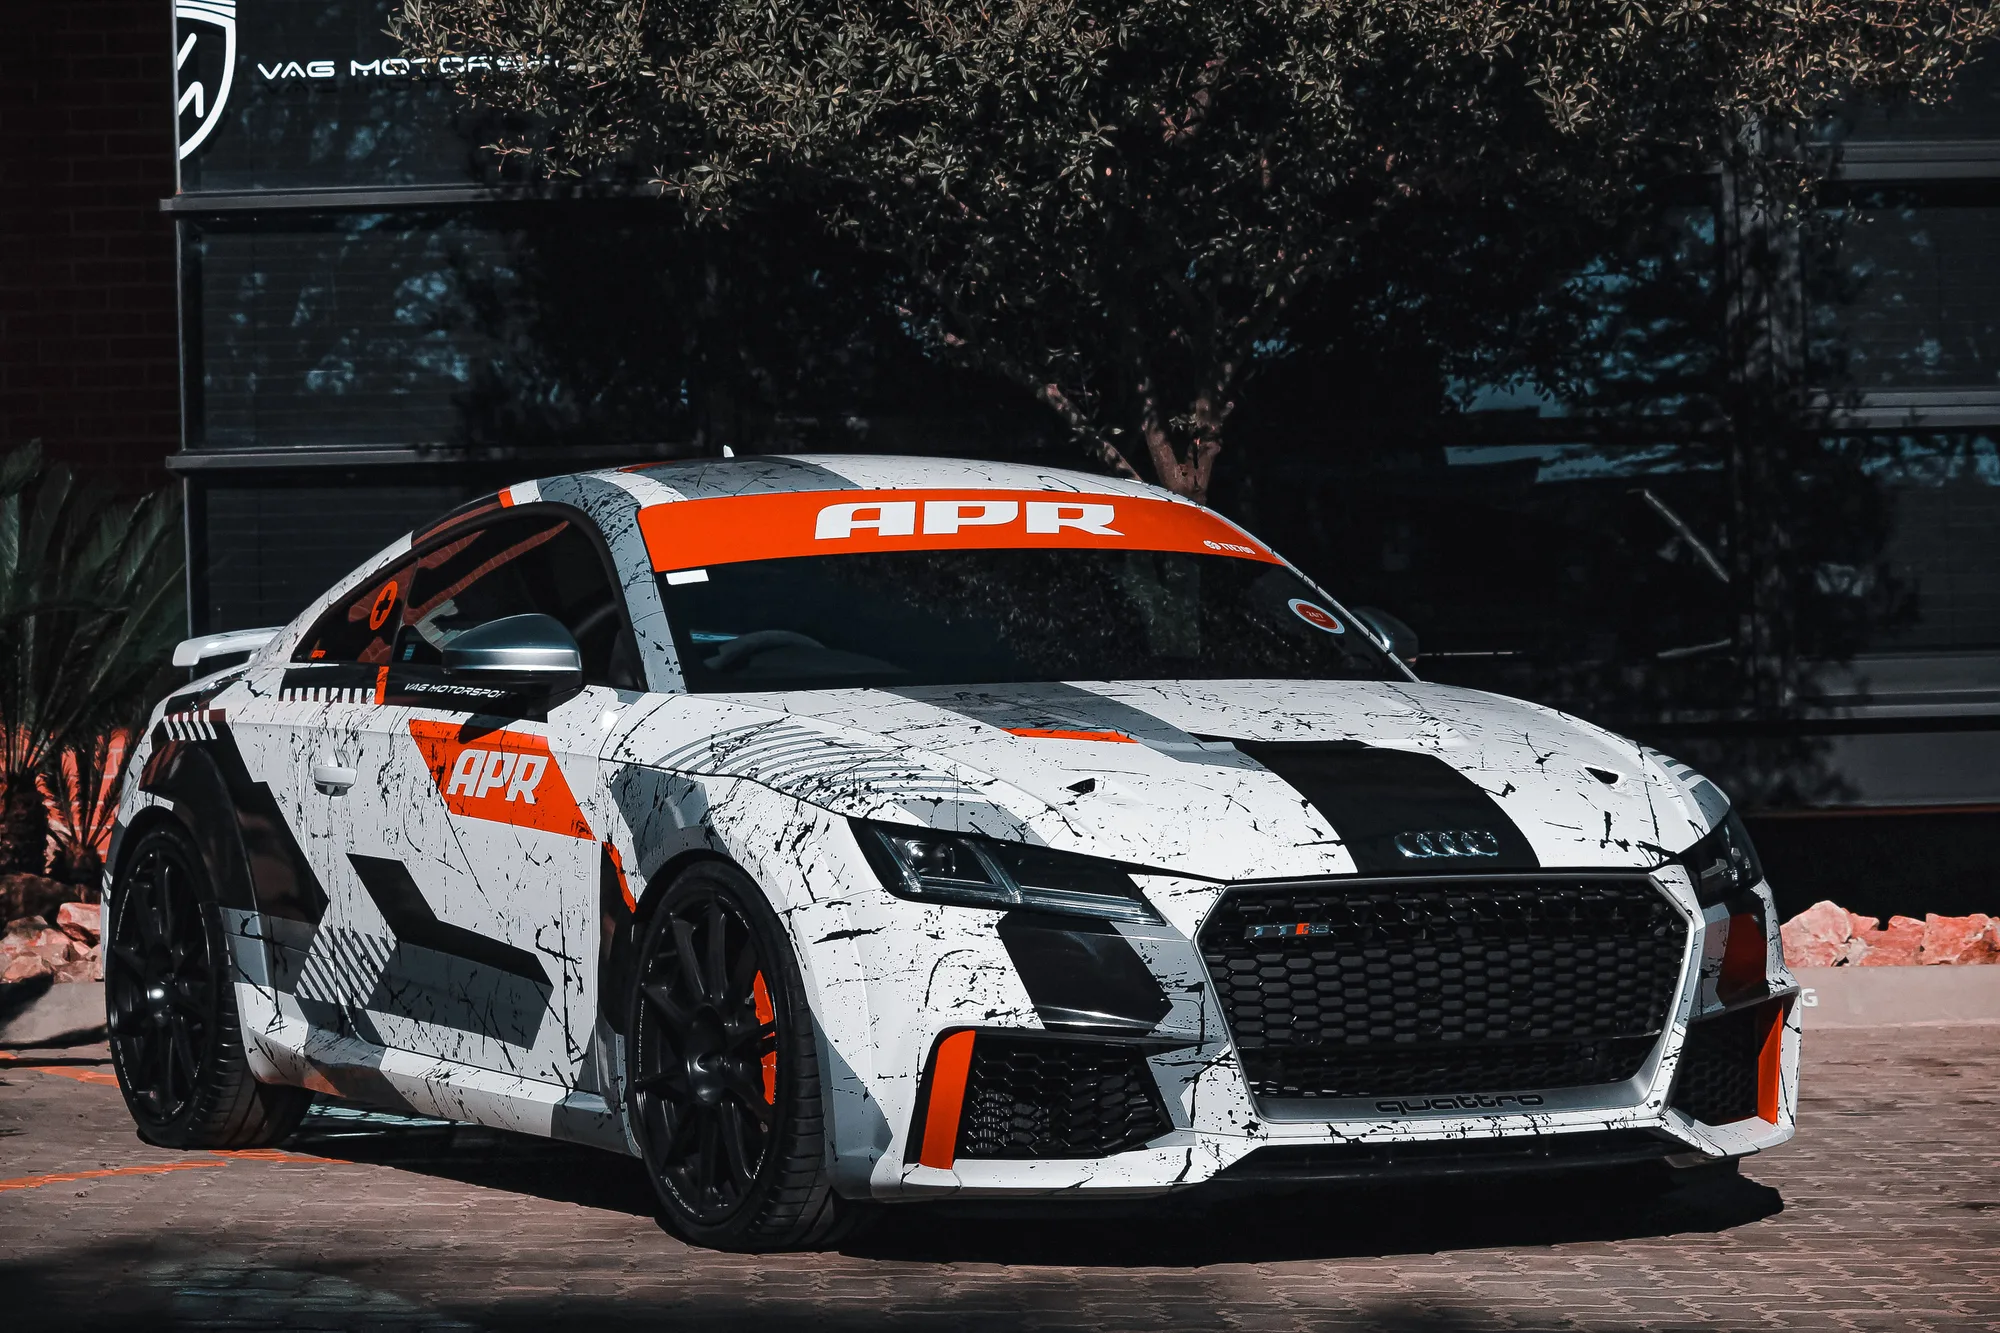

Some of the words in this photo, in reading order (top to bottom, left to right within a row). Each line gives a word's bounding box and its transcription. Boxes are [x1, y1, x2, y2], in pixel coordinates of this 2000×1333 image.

[257, 61, 335, 80] VAG
[814, 500, 1124, 540] APR
[404, 683, 430, 692] VAG
[428, 684, 514, 698] MOTORSPOR
[446, 748, 549, 805] APR
[1375, 1094, 1544, 1116] quattro
